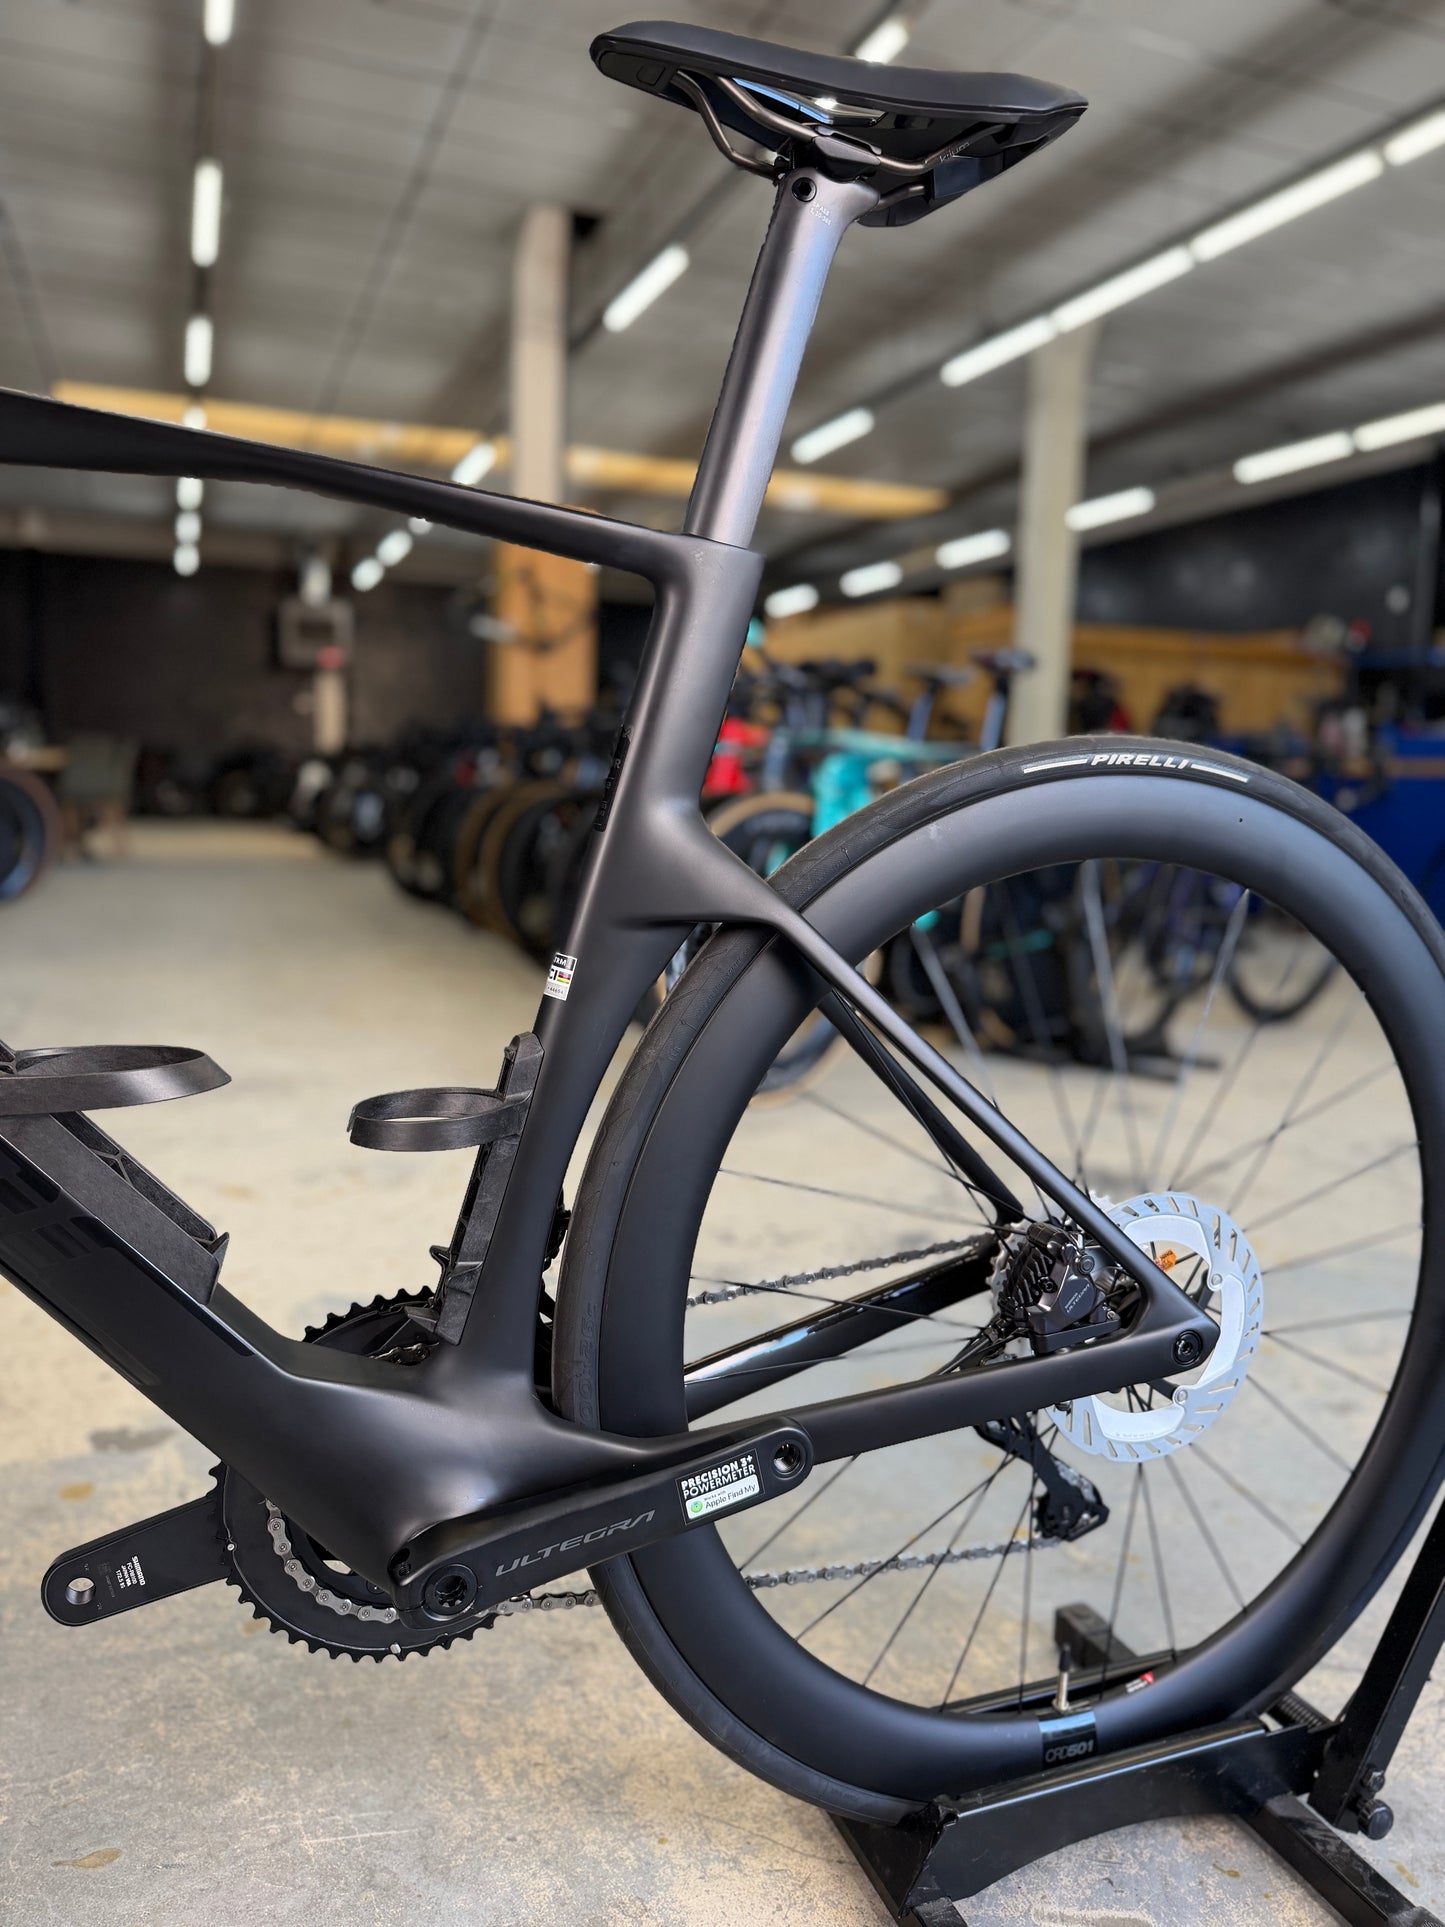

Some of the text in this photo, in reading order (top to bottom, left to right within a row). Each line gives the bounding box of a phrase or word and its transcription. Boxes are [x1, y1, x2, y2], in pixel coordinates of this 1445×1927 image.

[1091, 754, 1190, 770] PIRELLI
[681, 1455, 753, 1490] PRECISION 3+
[683, 1464, 756, 1500] POWERMETER
[705, 1483, 756, 1509] Apple Find My
[495, 1509, 656, 1577] ULTEGRA
[131, 1555, 146, 1586] SHIMANO
